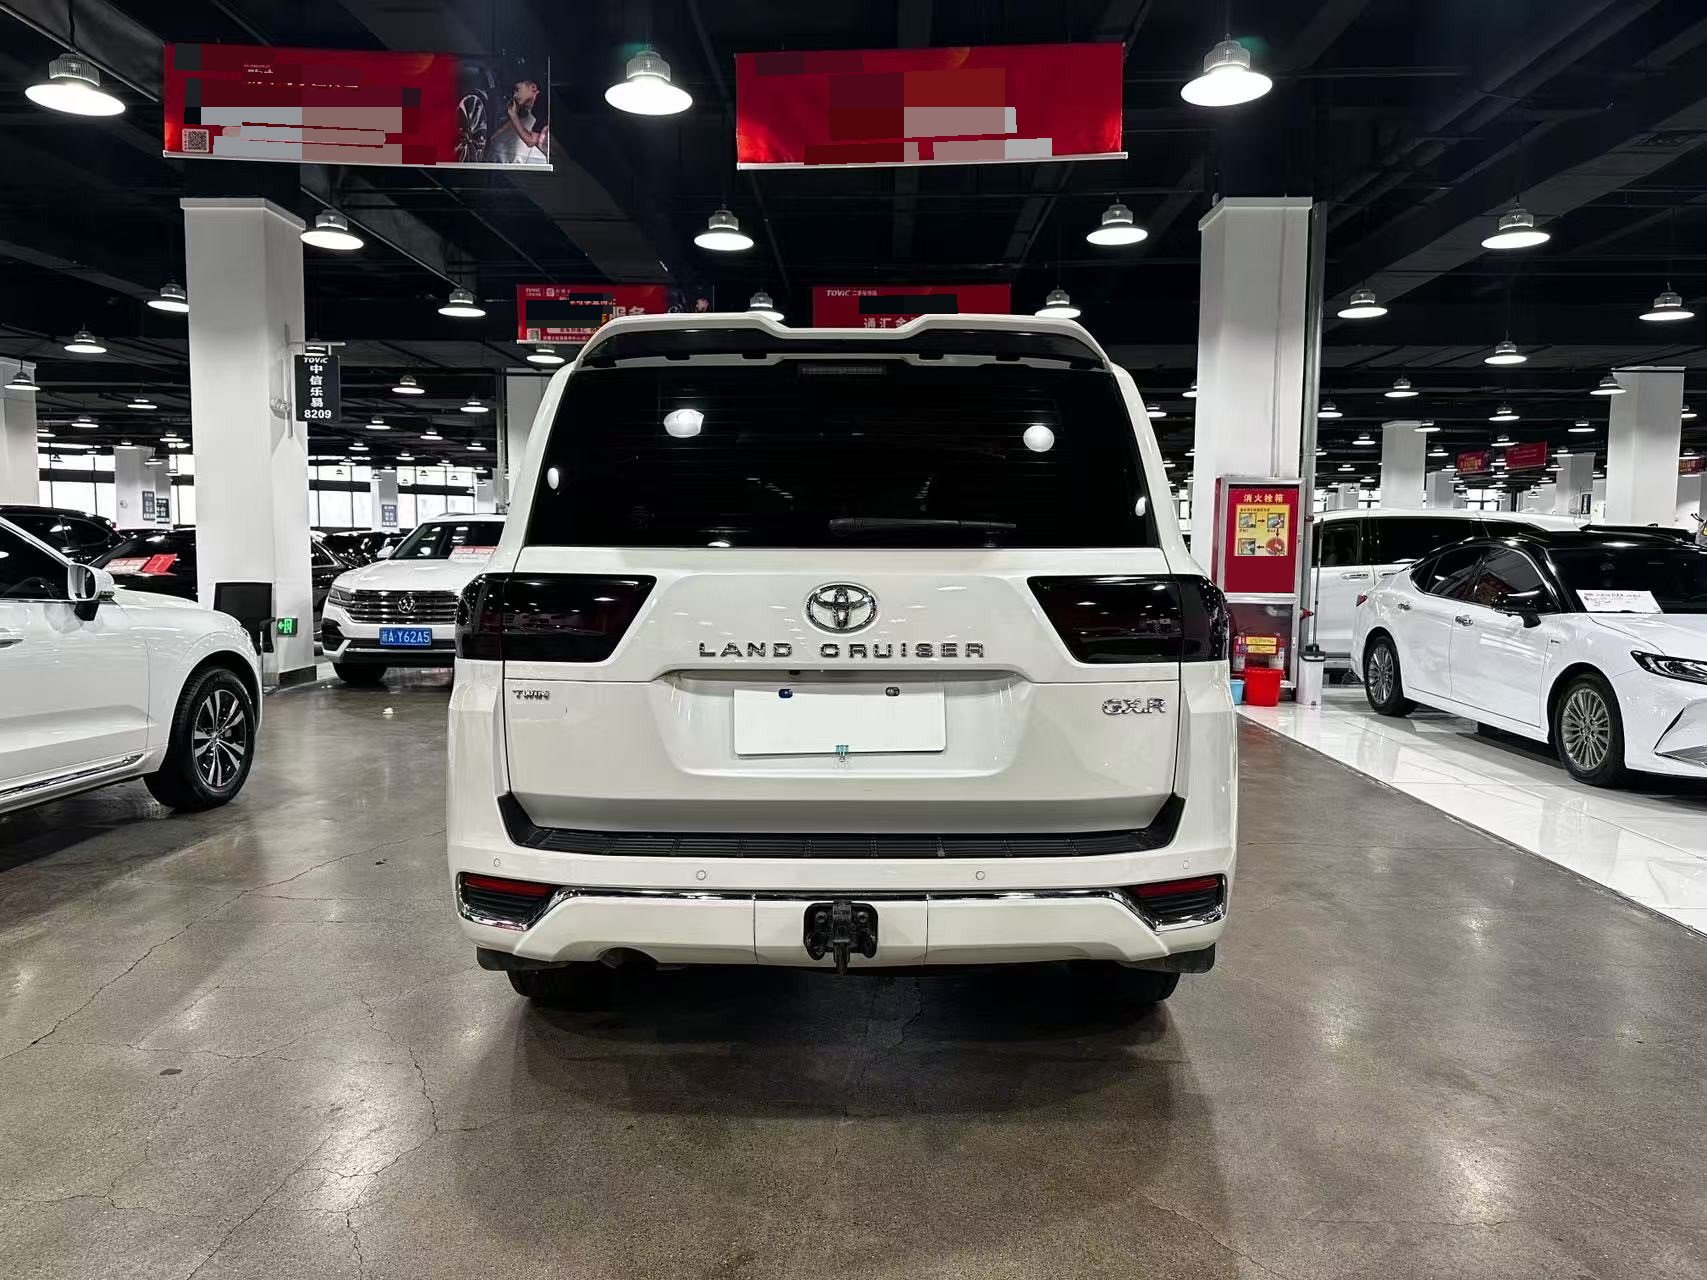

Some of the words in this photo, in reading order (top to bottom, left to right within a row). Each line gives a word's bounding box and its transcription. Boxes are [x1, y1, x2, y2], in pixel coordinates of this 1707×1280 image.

[304, 409, 331, 418] 8209
[1243, 493, 1284, 503] 消火栓箱
[699, 642, 793, 657] LAND
[820, 642, 984, 658] CRUISER
